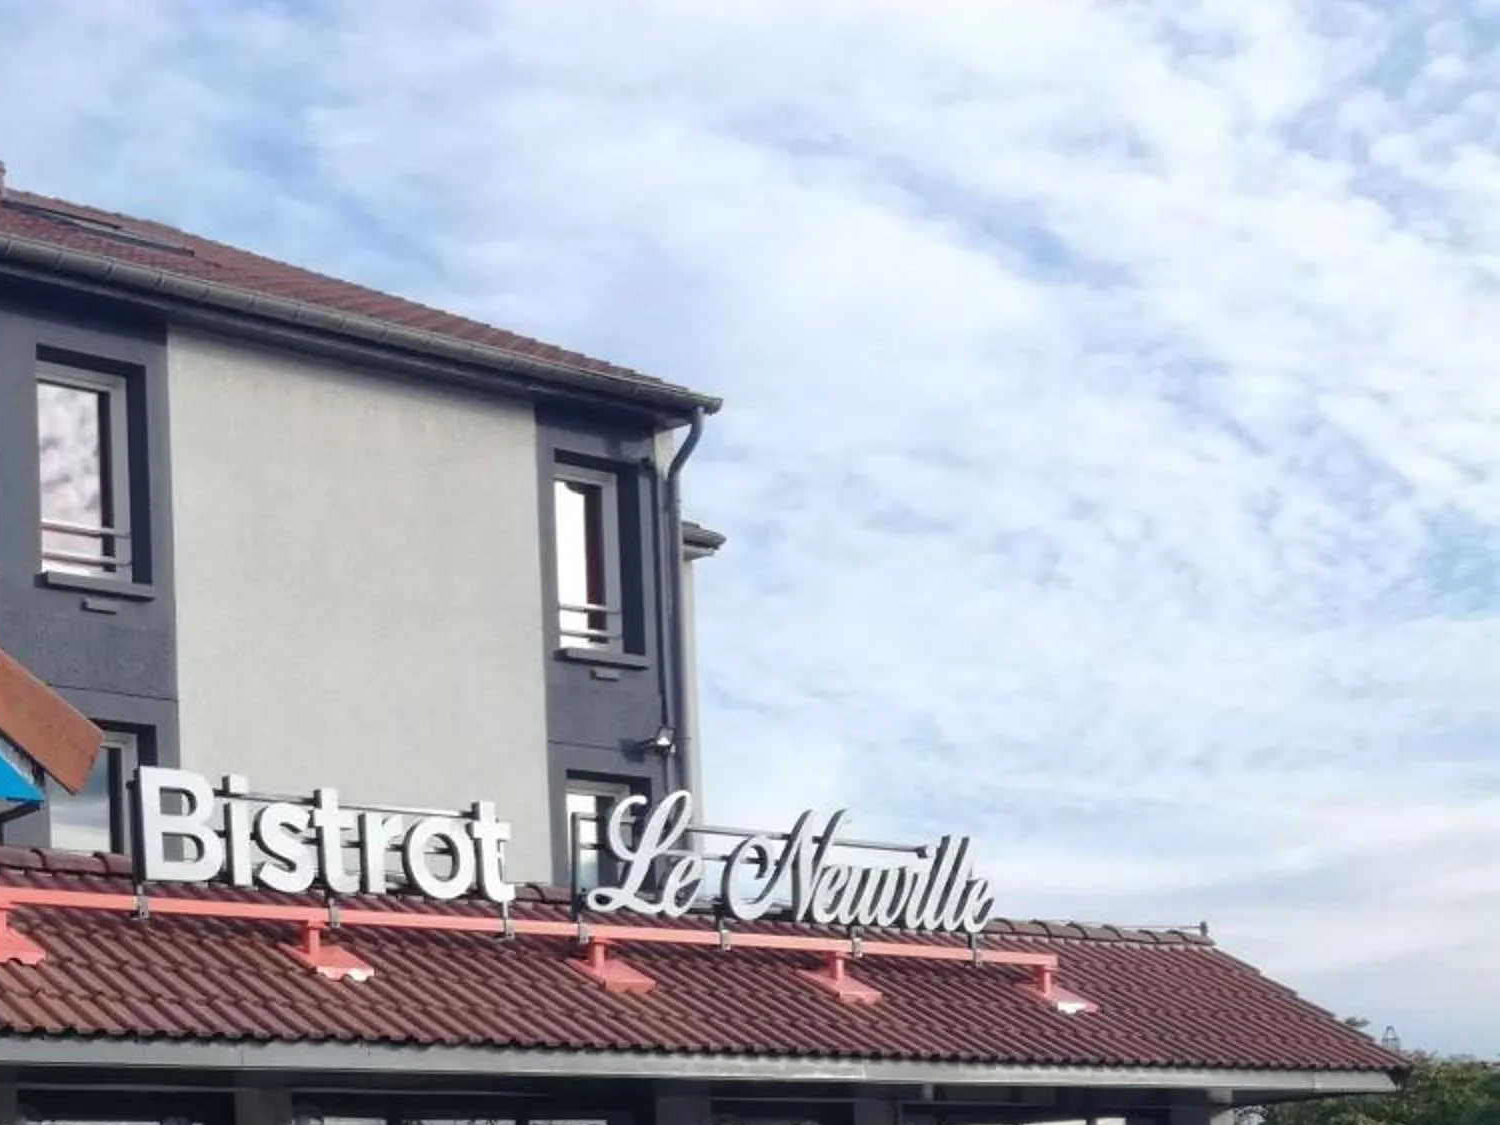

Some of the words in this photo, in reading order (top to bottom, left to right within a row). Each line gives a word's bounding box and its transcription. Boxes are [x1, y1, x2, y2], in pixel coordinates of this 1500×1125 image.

[136, 767, 513, 902] Bistrot
[587, 790, 702, 916] Le
[724, 809, 995, 933] Neuville
